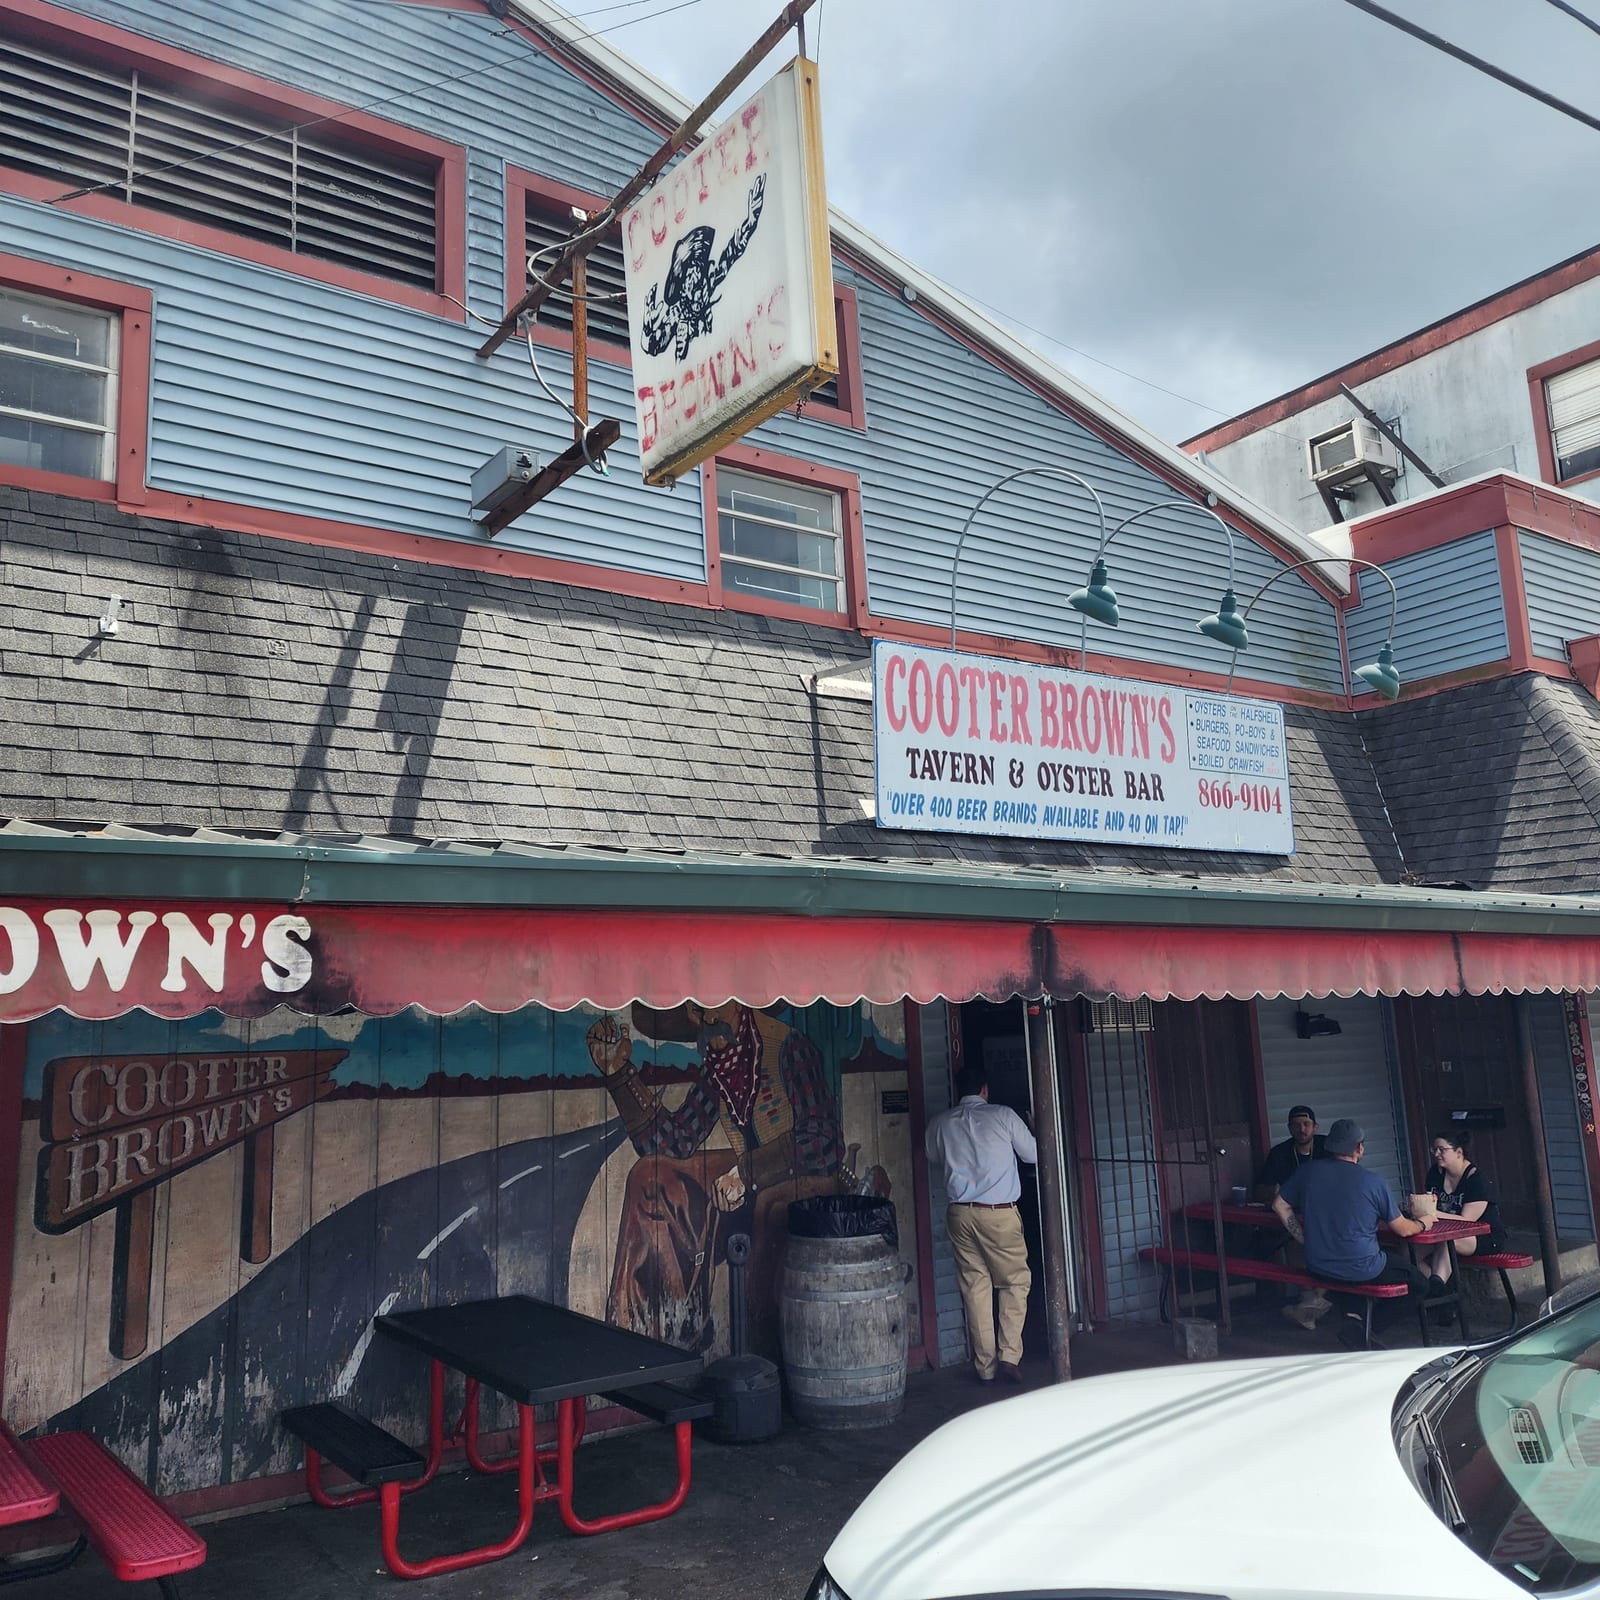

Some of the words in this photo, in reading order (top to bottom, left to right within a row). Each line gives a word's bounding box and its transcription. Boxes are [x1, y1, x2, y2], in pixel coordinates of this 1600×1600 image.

[885, 655, 1032, 746] COOTER
[1038, 679, 1176, 763] BROWN'S
[1195, 701, 1226, 717] OYSTERS
[1240, 707, 1279, 724] HALFSHELL
[1196, 719, 1231, 737] BURGERS,
[1235, 723, 1266, 739] PO-BOYS
[1270, 729, 1275, 740] &
[1197, 736, 1230, 752] SEAFOOD
[1235, 740, 1279, 758] SANDWICHES
[906, 747, 994, 786] TAVERN
[1009, 758, 1023, 789] &
[1037, 761, 1114, 797] OYSTER
[1124, 770, 1165, 802] BAR
[1198, 754, 1224, 768] BOILED
[1228, 757, 1264, 772] CRAWFISH
[887, 791, 925, 816] "OVER
[930, 796, 952, 818] 400
[956, 798, 987, 822] BEER
[993, 800, 1037, 826] BRANDS
[1043, 805, 1099, 830] AVAILABLE
[1104, 810, 1125, 832] AND
[1128, 813, 1140, 834] 40
[1145, 814, 1158, 835] ON
[1163, 814, 1188, 836] TAP!"
[1198, 778, 1282, 814] 866-9104
[69, 1055, 289, 1127] COOTER
[62, 1087, 293, 1214] BROWN'S
